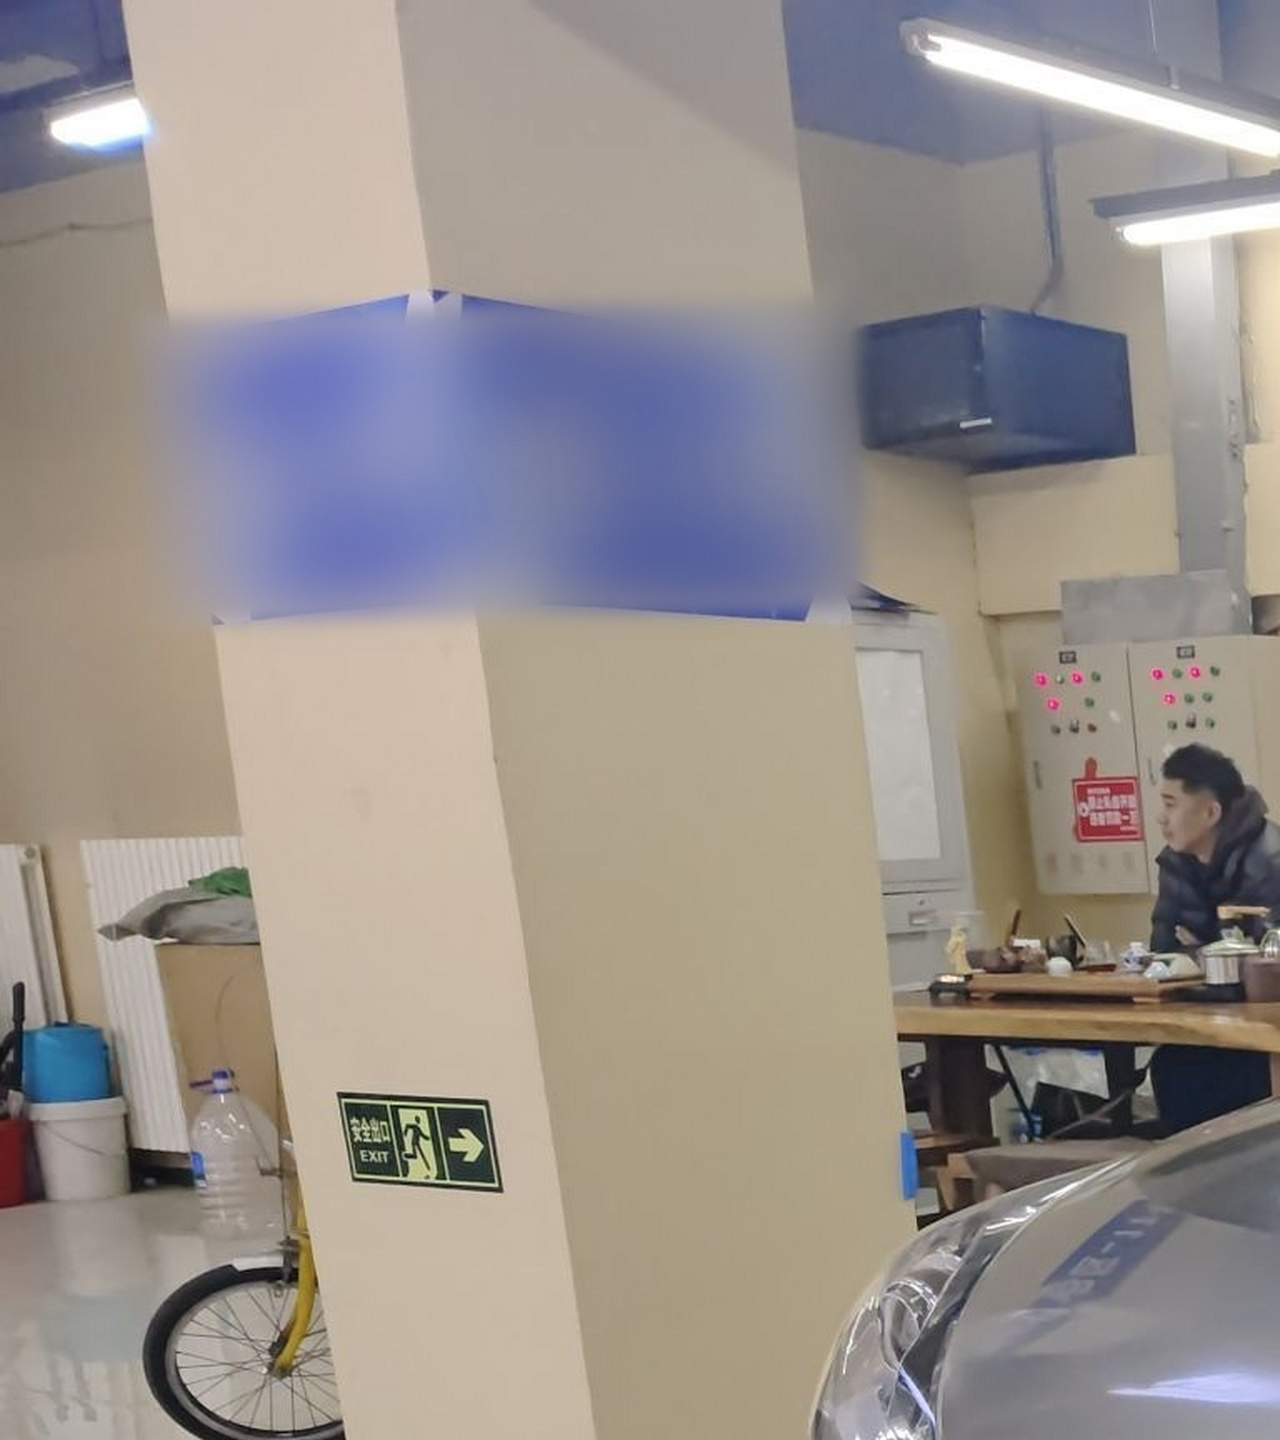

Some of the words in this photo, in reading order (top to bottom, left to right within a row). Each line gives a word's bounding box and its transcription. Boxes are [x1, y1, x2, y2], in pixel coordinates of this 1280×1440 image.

[350, 1116, 391, 1142] 安全出口
[360, 1150, 389, 1163] EXIT
